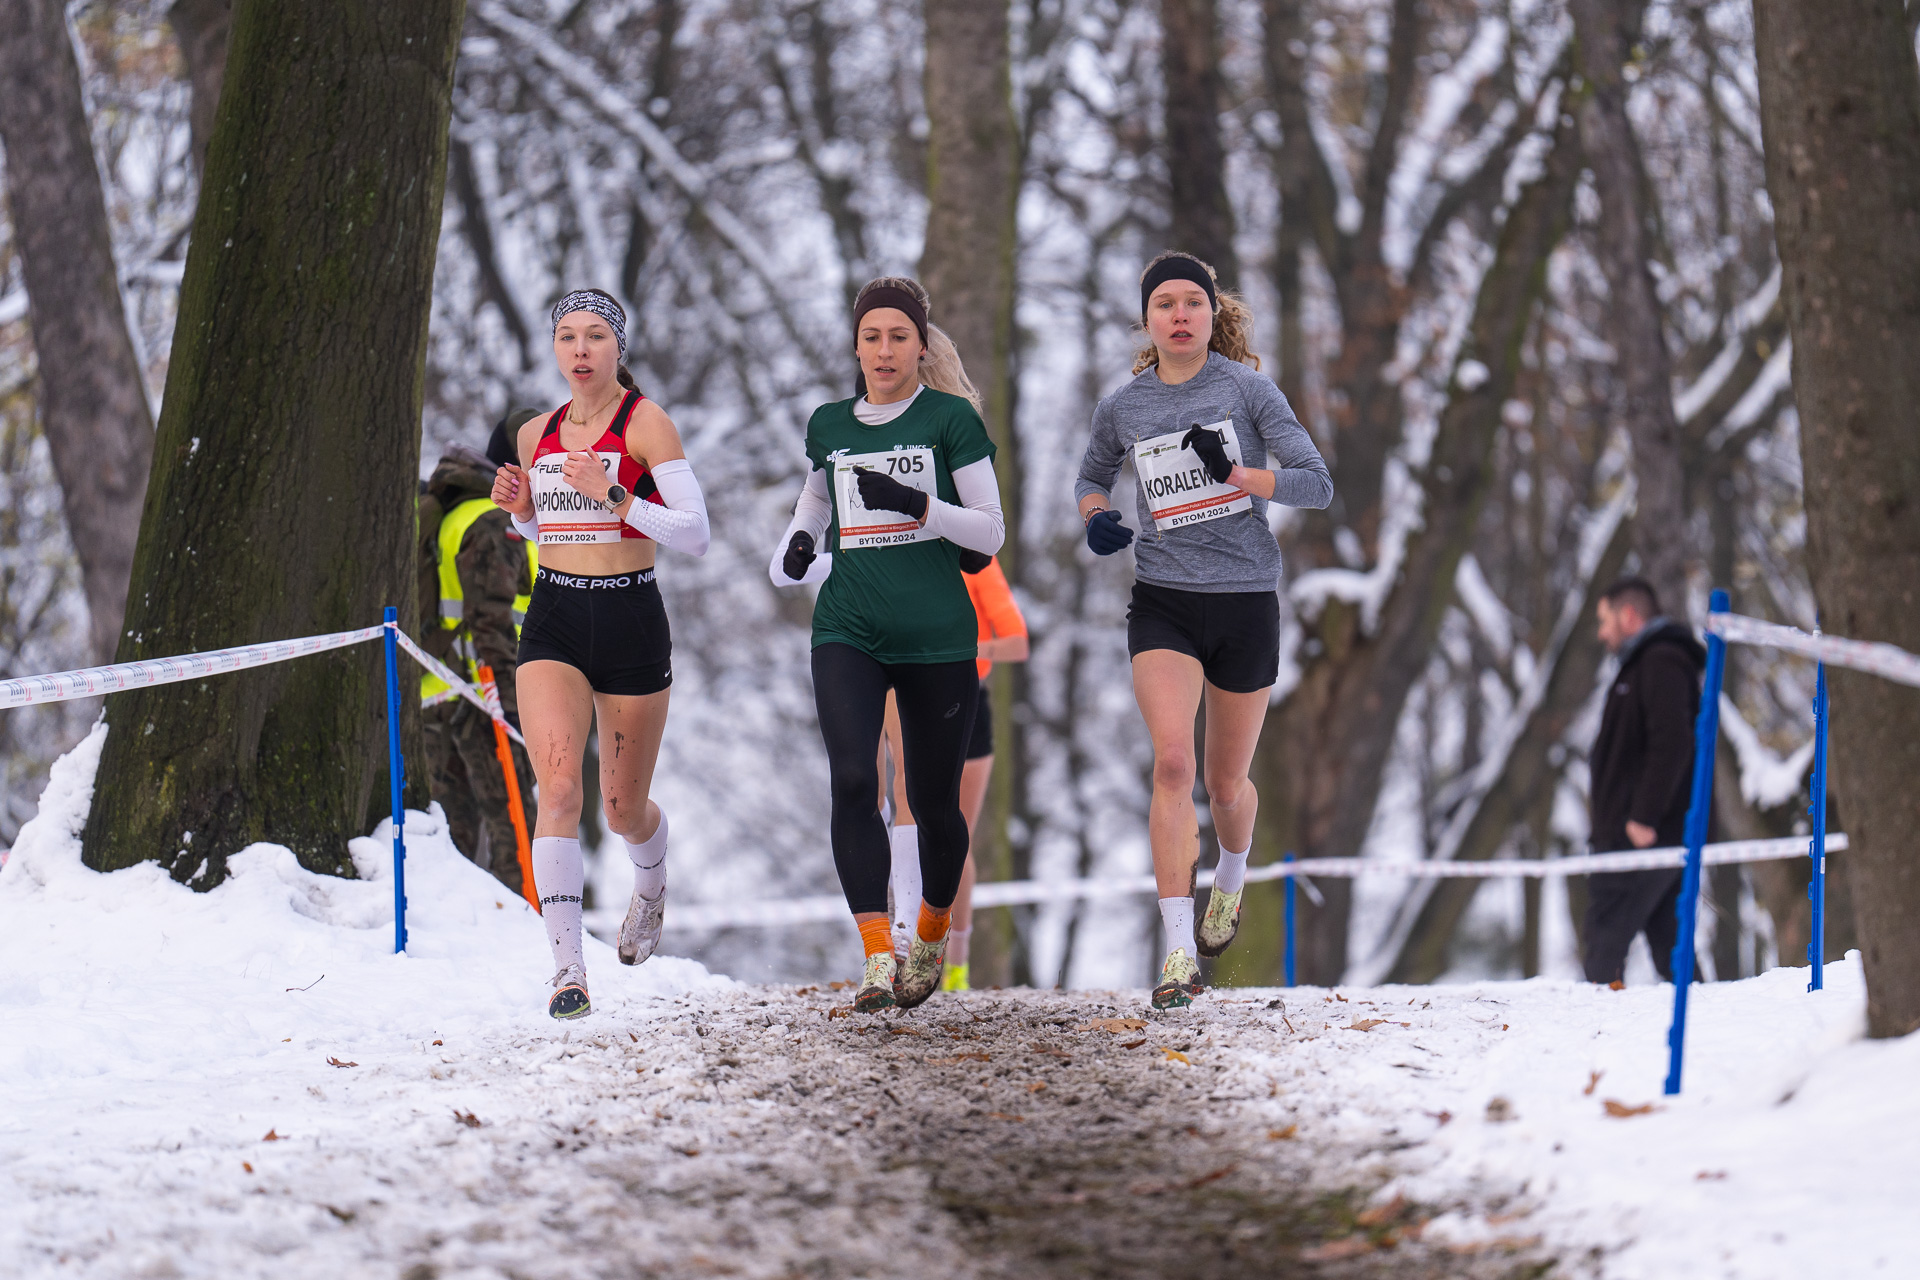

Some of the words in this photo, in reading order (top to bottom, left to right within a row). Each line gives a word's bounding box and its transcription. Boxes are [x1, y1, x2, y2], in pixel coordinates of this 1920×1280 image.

[886, 455, 924, 475] 705
[1172, 512, 1206, 526] BYTOM
[1207, 506, 1230, 518] 2024
[544, 534, 574, 542] BYTOM
[574, 534, 597, 542] 2024
[859, 536, 891, 546] BYTOM
[892, 533, 916, 543] 2024
[549, 572, 589, 589] NIKE
[589, 576, 631, 590] PRO
[540, 895, 584, 905] RESSP
